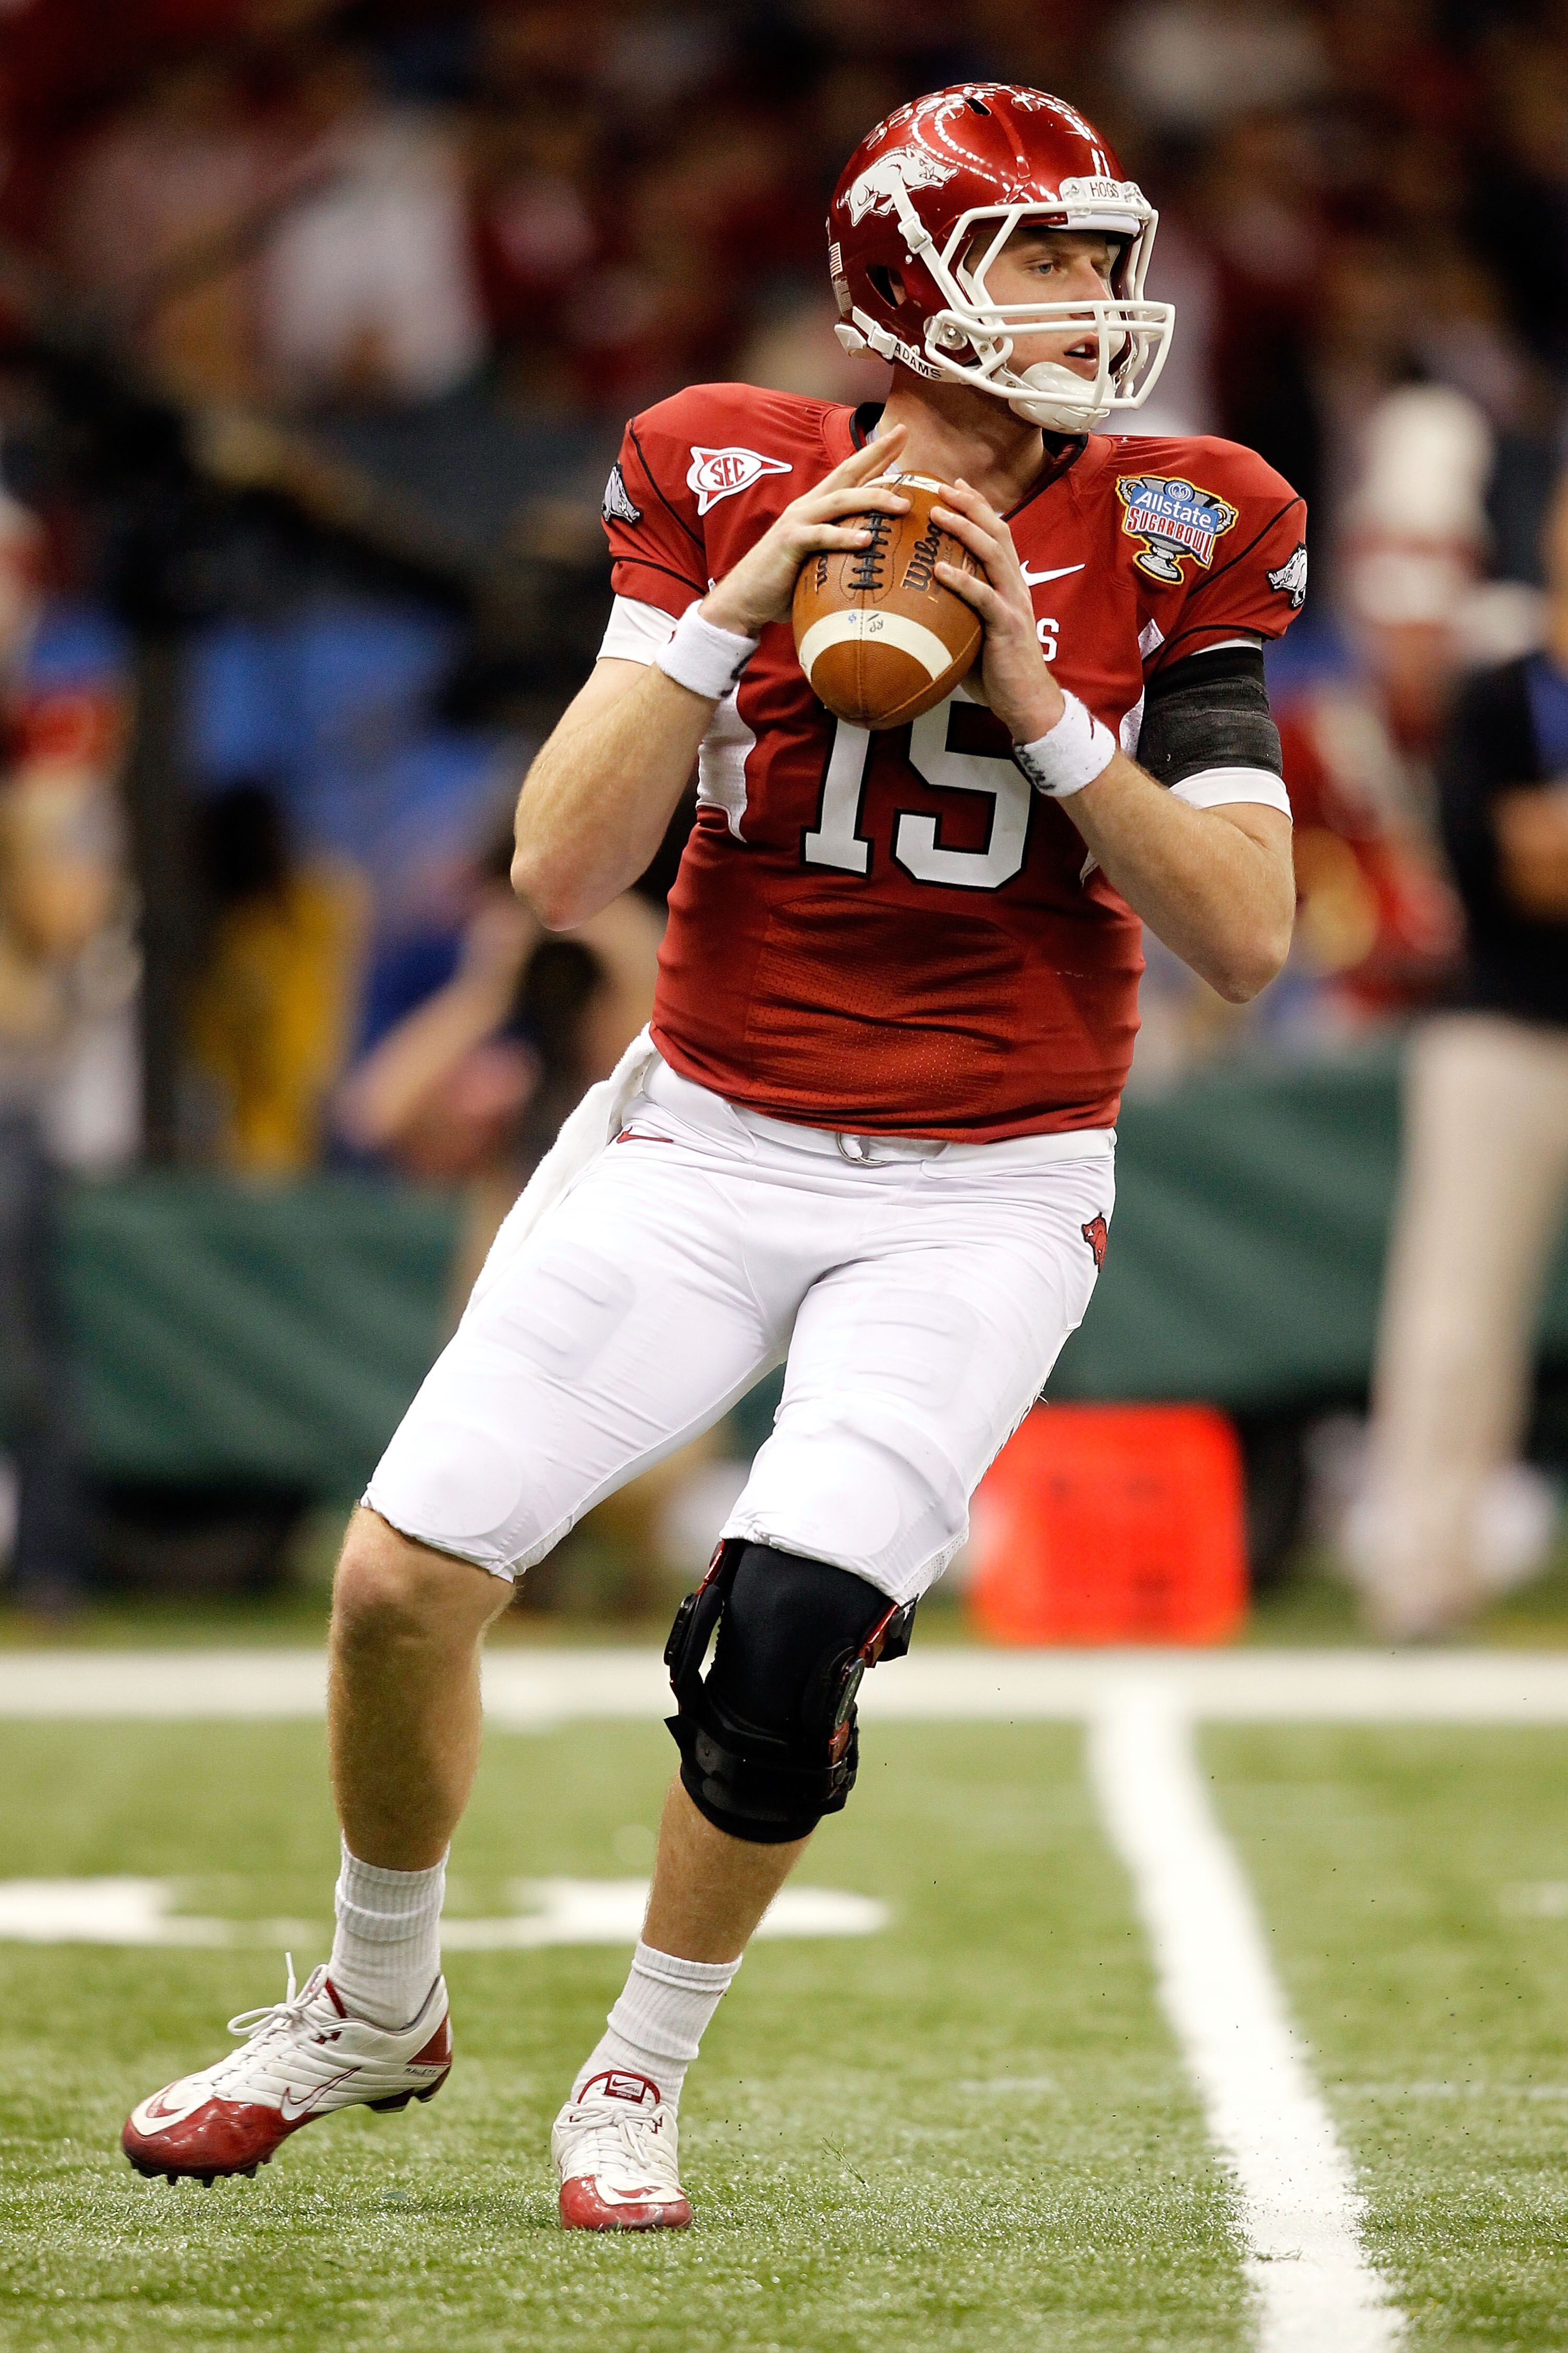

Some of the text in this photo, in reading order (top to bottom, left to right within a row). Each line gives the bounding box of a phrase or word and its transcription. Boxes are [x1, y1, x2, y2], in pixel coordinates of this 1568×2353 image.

[1090, 182, 1119, 198] HOGS
[895, 343, 941, 378] ADAMS
[710, 457, 745, 487] SEC
[1134, 491, 1212, 529] Allstate
[902, 518, 942, 592] Wilso
[805, 685, 1032, 888] 15
